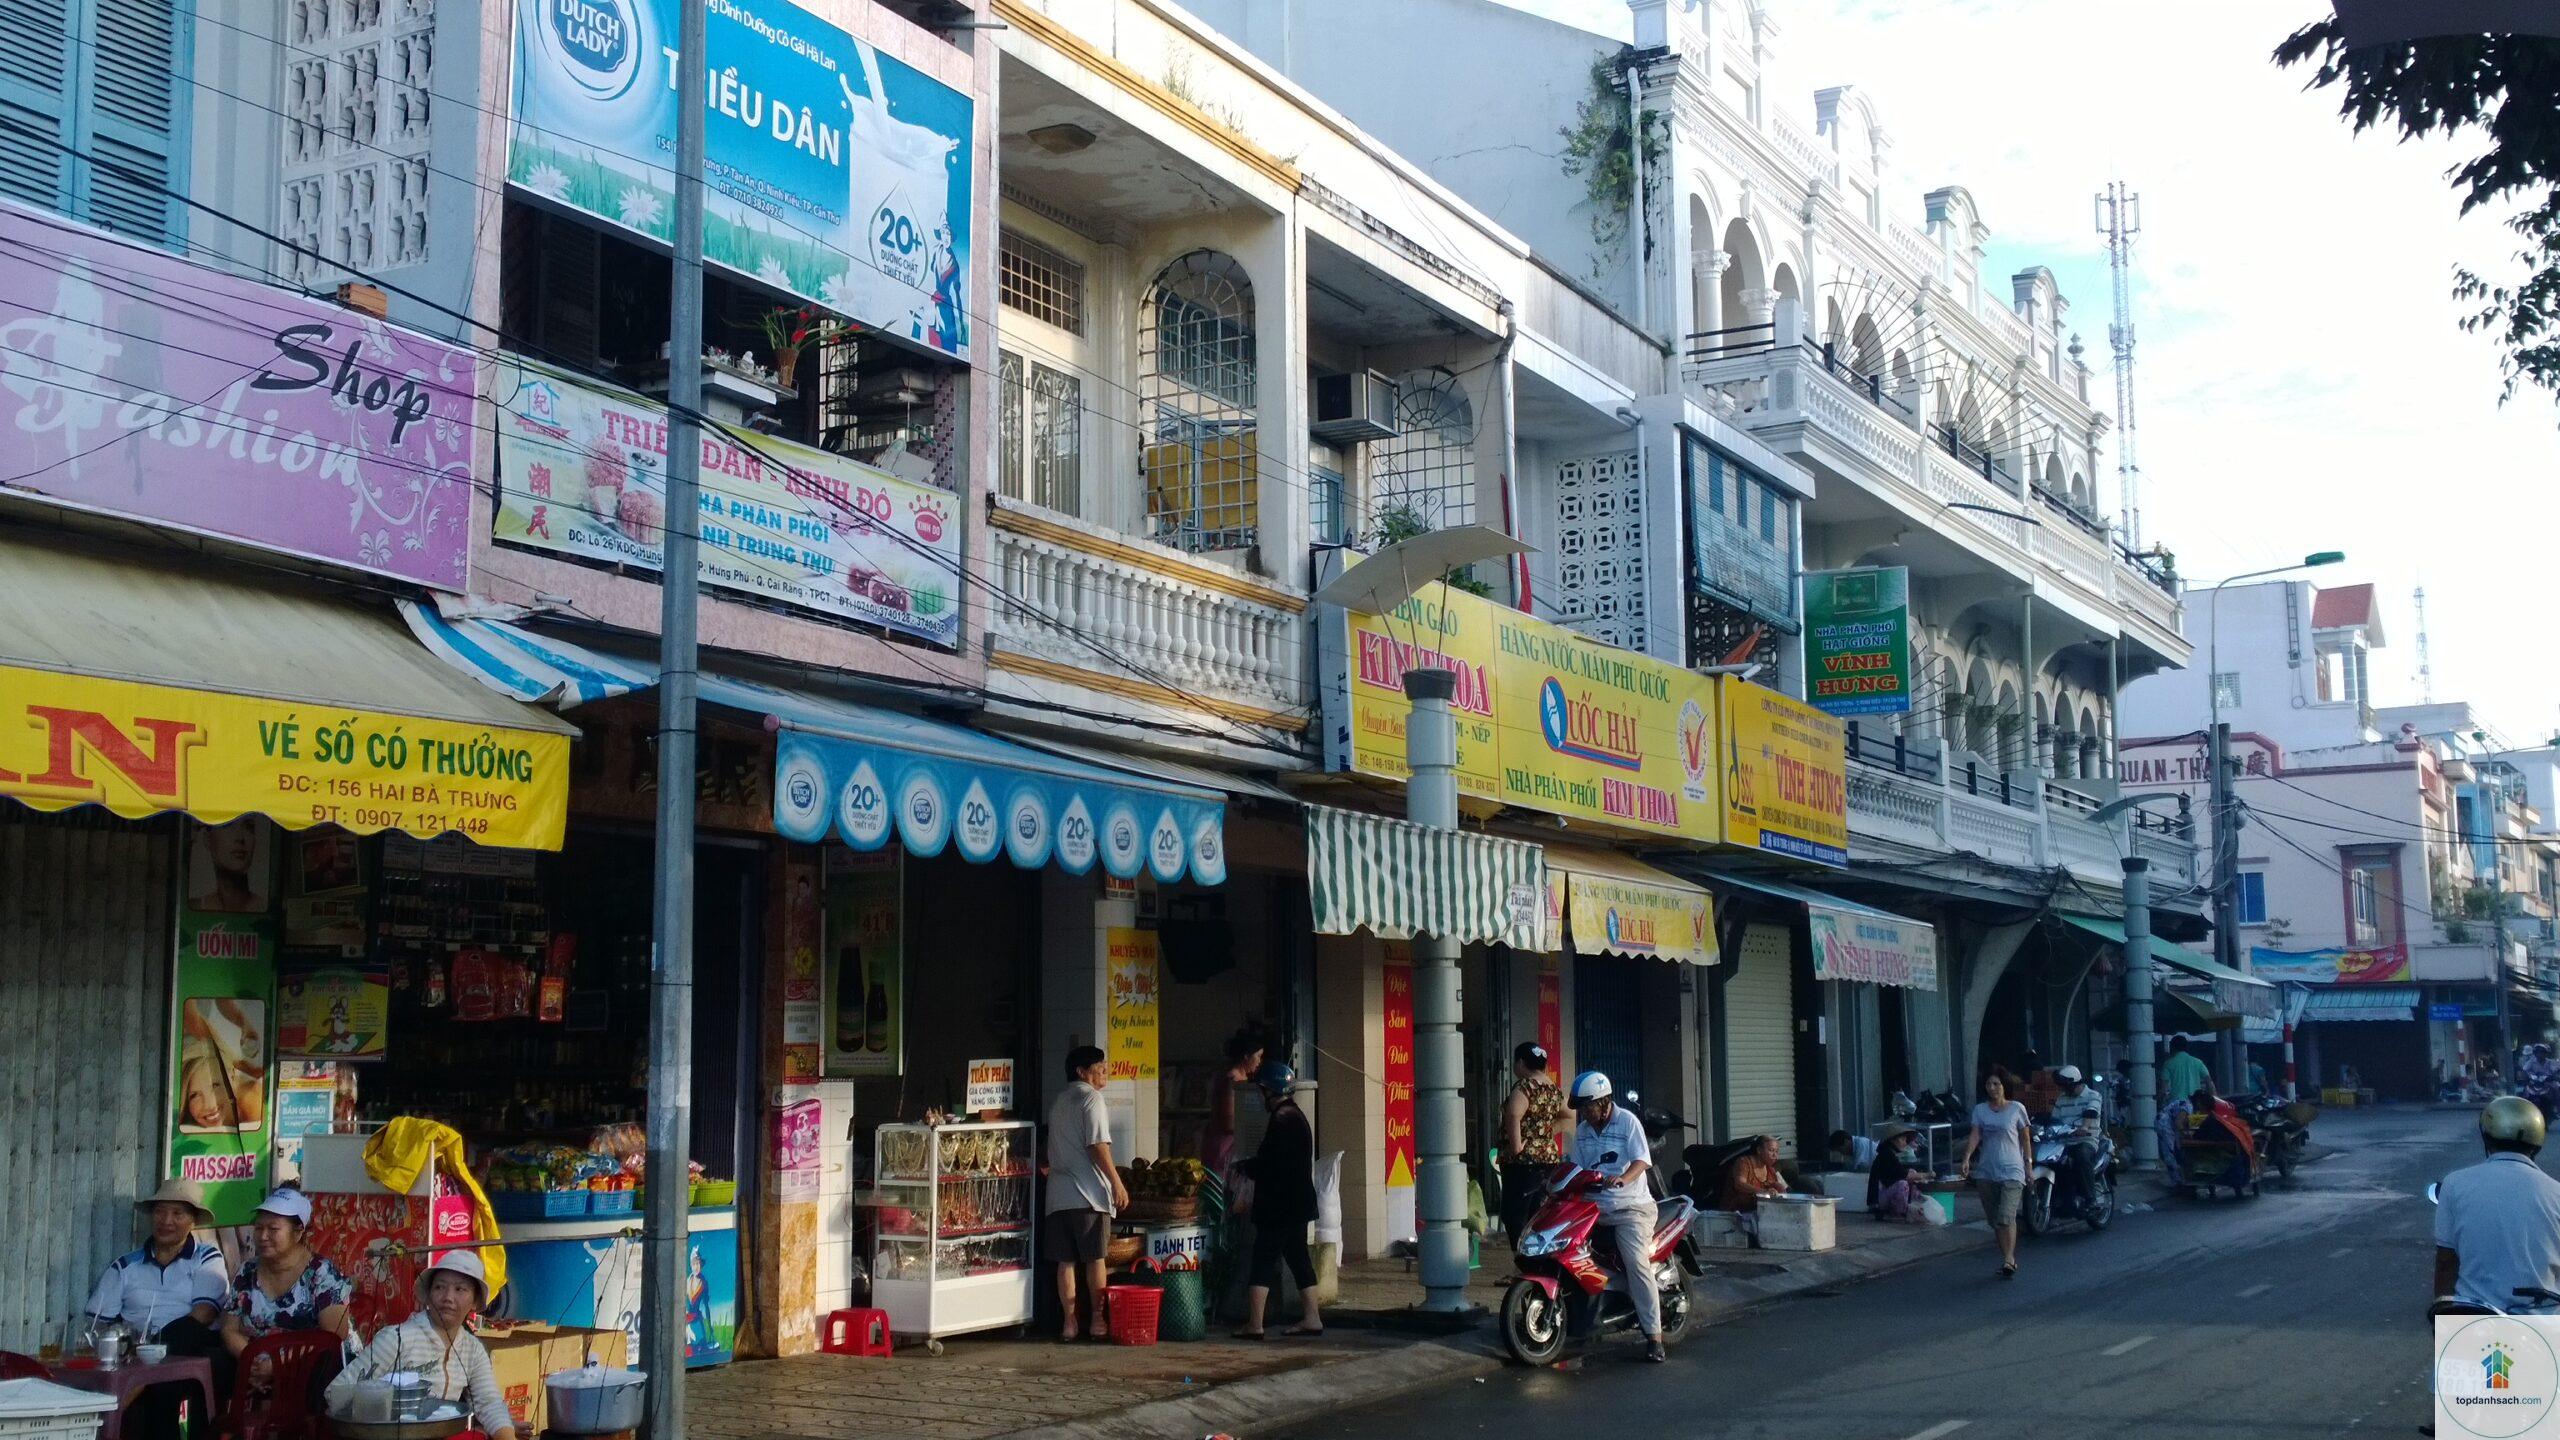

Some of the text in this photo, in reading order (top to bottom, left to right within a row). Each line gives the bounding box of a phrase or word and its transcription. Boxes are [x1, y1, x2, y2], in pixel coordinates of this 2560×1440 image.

[560, 0, 619, 40] DUTCH
[566, 20, 612, 58] LADY
[776, 29, 789, 47] Cô
[806, 43, 819, 62] Hà
[820, 51, 836, 72] Lan
[663, 45, 840, 167] TIỀU DÂN
[879, 207, 922, 255] 20+
[250, 324, 430, 444] Shop
[784, 464, 850, 509] KINH
[856, 486, 893, 522] ĐÔ
[738, 533, 797, 565] TRUNG
[602, 535, 614, 551] 26
[708, 564, 731, 581] Hưng
[733, 568, 750, 583] Phú
[809, 588, 831, 602] TPCT
[916, 616, 945, 634] 3740435
[1391, 597, 1423, 630] IỆM
[1815, 618, 1897, 637] NHÀ PHÂN PHỐI
[1848, 633, 1890, 649] GIỐNG
[1357, 629, 1418, 693] KIM
[1499, 622, 1671, 704] HÀNG NƯỚC MẮM PHÚ QUỐC
[1823, 652, 1892, 672] VĨNH
[1816, 674, 1899, 696] HƯNG
[1471, 722, 1491, 744] NẾP
[1606, 702, 1638, 755] HẢI
[258, 713, 533, 784] VÉ SỐ CÓ THƯỞNG
[278, 773, 517, 811] ĐC: 156 HAI BÀ TRƯNG
[851, 783, 881, 811] 20+
[1505, 764, 1532, 795] NHÀ
[1535, 771, 1567, 801] PHÂN
[1570, 777, 1597, 808] PHỐI
[1602, 777, 1636, 818] KIM
[1637, 786, 1681, 828] THOA
[1775, 748, 1843, 817] VĨNH HƯNG
[455, 817, 488, 834] 448
[966, 800, 991, 827] 20+
[1066, 815, 1090, 840] 20+
[1158, 828, 1178, 851] 20+
[197, 923, 259, 960] UỐN MI
[990, 1062, 1011, 1083] PHÁT
[1110, 1060, 1138, 1081] 20kg
[182, 1153, 257, 1183] MASSAGE
[1154, 1231, 1207, 1256] BÁNH TẾT
